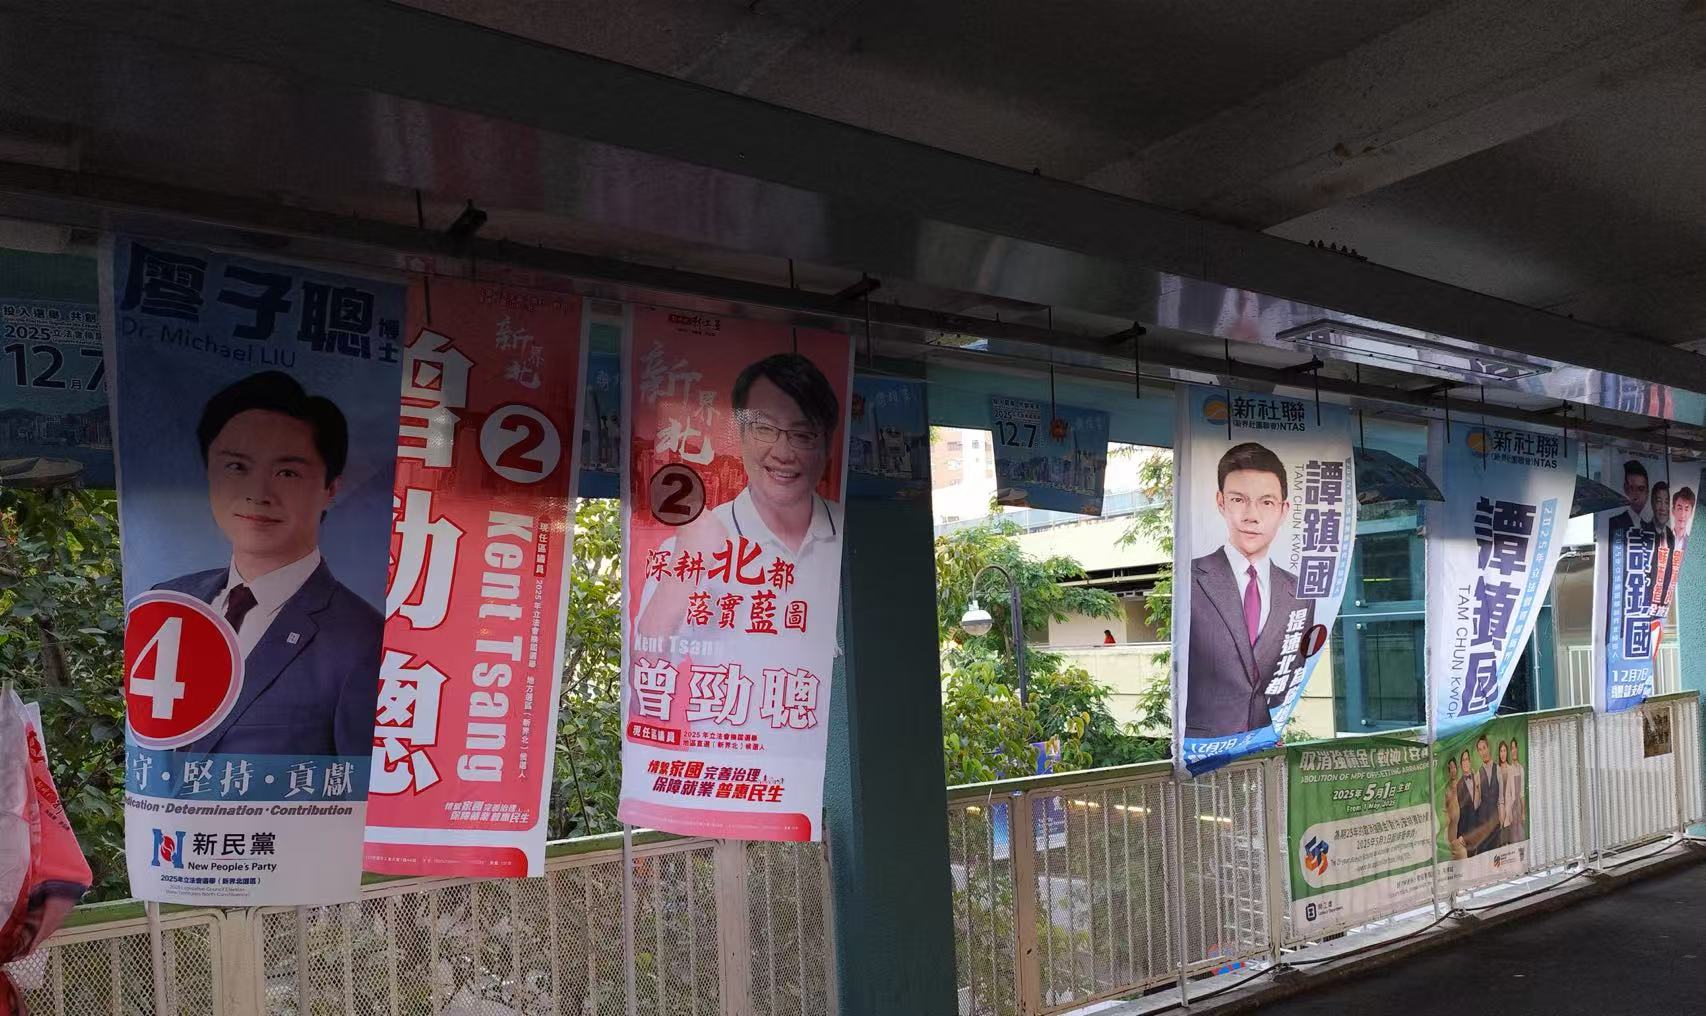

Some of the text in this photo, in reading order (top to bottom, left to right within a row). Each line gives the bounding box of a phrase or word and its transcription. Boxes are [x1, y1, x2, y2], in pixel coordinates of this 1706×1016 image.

[119, 241, 374, 361] 廖子聰
[160, 324, 252, 361] Michael
[261, 351, 296, 368] LIU
[1232, 396, 1305, 422] 新社聯
[495, 413, 545, 474] 2
[1493, 430, 1560, 459] 新社聯
[657, 472, 695, 517] 2
[1288, 463, 1305, 571] TAM CHUN KWOK
[1294, 459, 1344, 599] 譚鎮國
[645, 536, 796, 594] 深耕北都
[684, 589, 809, 636] 落實藍圖
[1457, 585, 1471, 621] TAM
[129, 616, 186, 720] 4
[455, 510, 534, 783] Kent Tsang
[1453, 626, 1467, 672] CHUN
[633, 657, 821, 730] 曾勁聰
[187, 862, 277, 873] New People's Party
[193, 832, 277, 856] 新民黨
